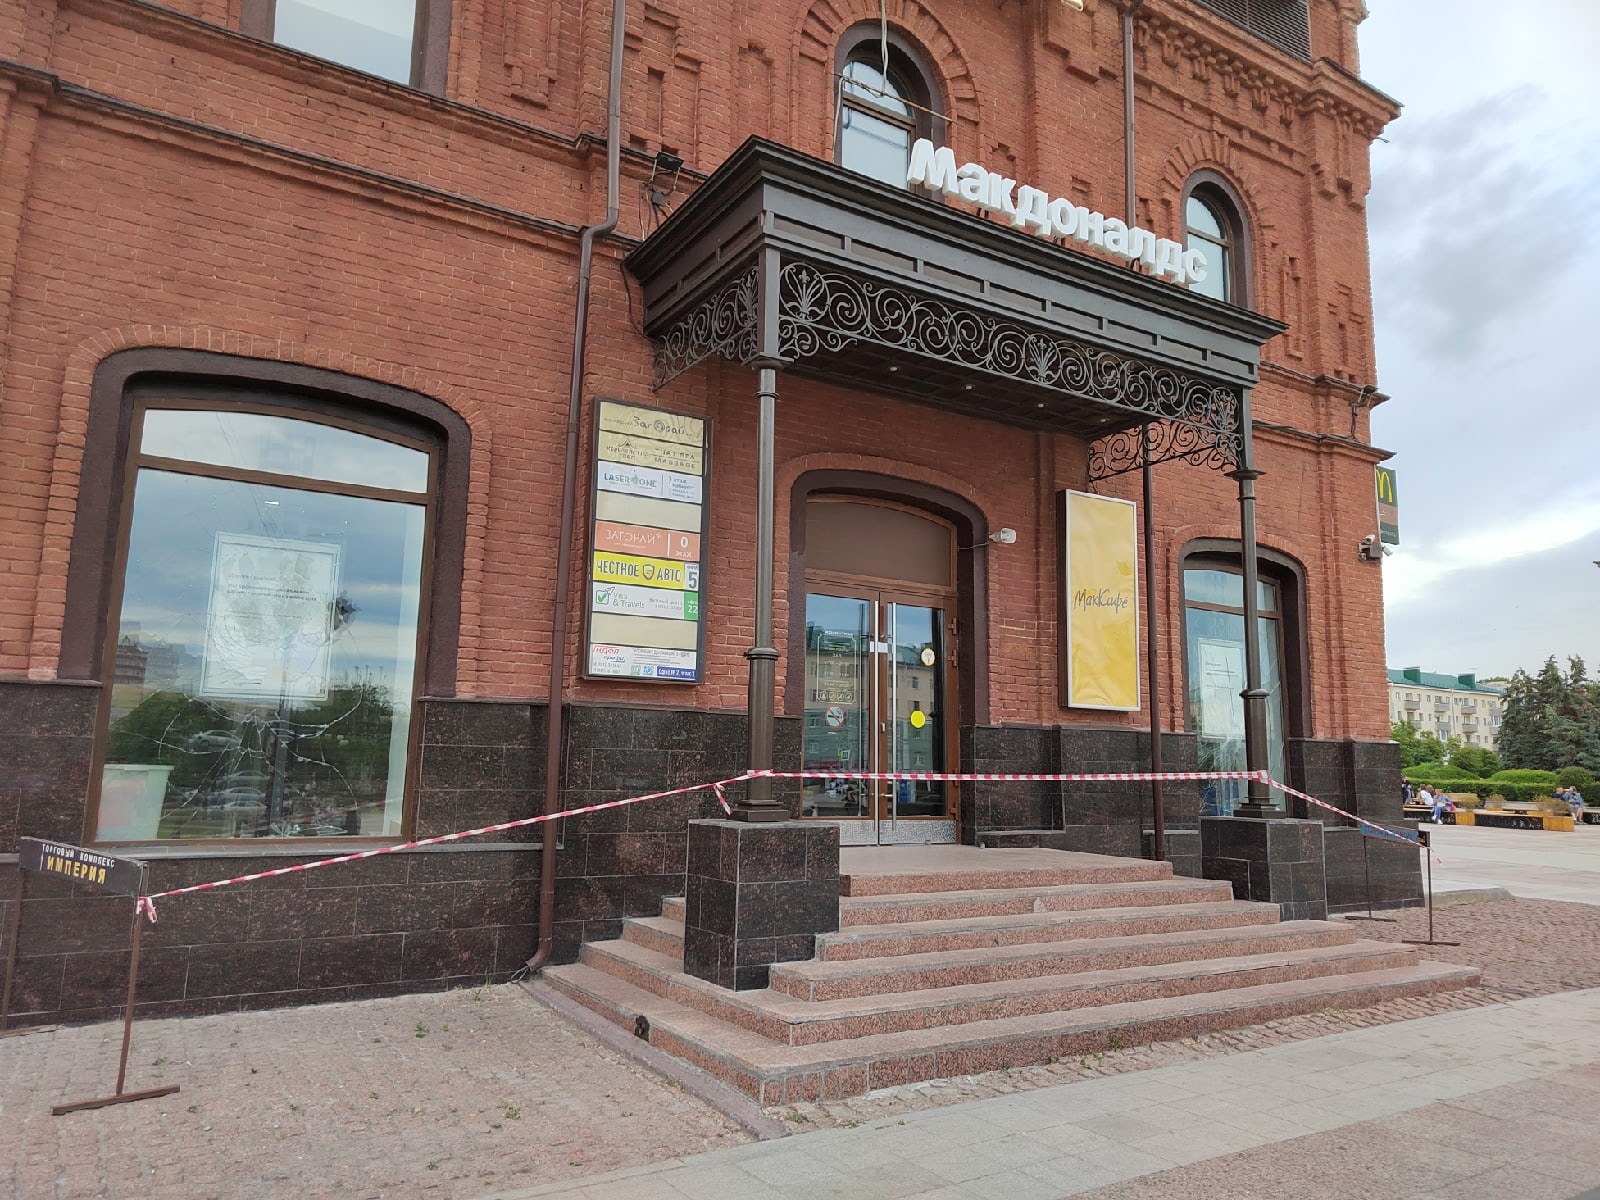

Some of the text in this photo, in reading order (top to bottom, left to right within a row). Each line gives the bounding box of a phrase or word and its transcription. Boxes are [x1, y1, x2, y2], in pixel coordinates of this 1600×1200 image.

[907, 138, 1207, 284] Макдоналдс
[604, 472, 630, 484] LASER
[639, 478, 657, 488] ONE
[596, 560, 681, 582] ЧЕСТНОЕ АВТО
[688, 571, 697, 589] 5
[612, 598, 619, 607] &
[687, 604, 698, 614] 22
[42, 843, 116, 868] ТОРГОВЫЙ КОМПЛЕКС
[47, 855, 107, 885] ИМПЕРИЯ
